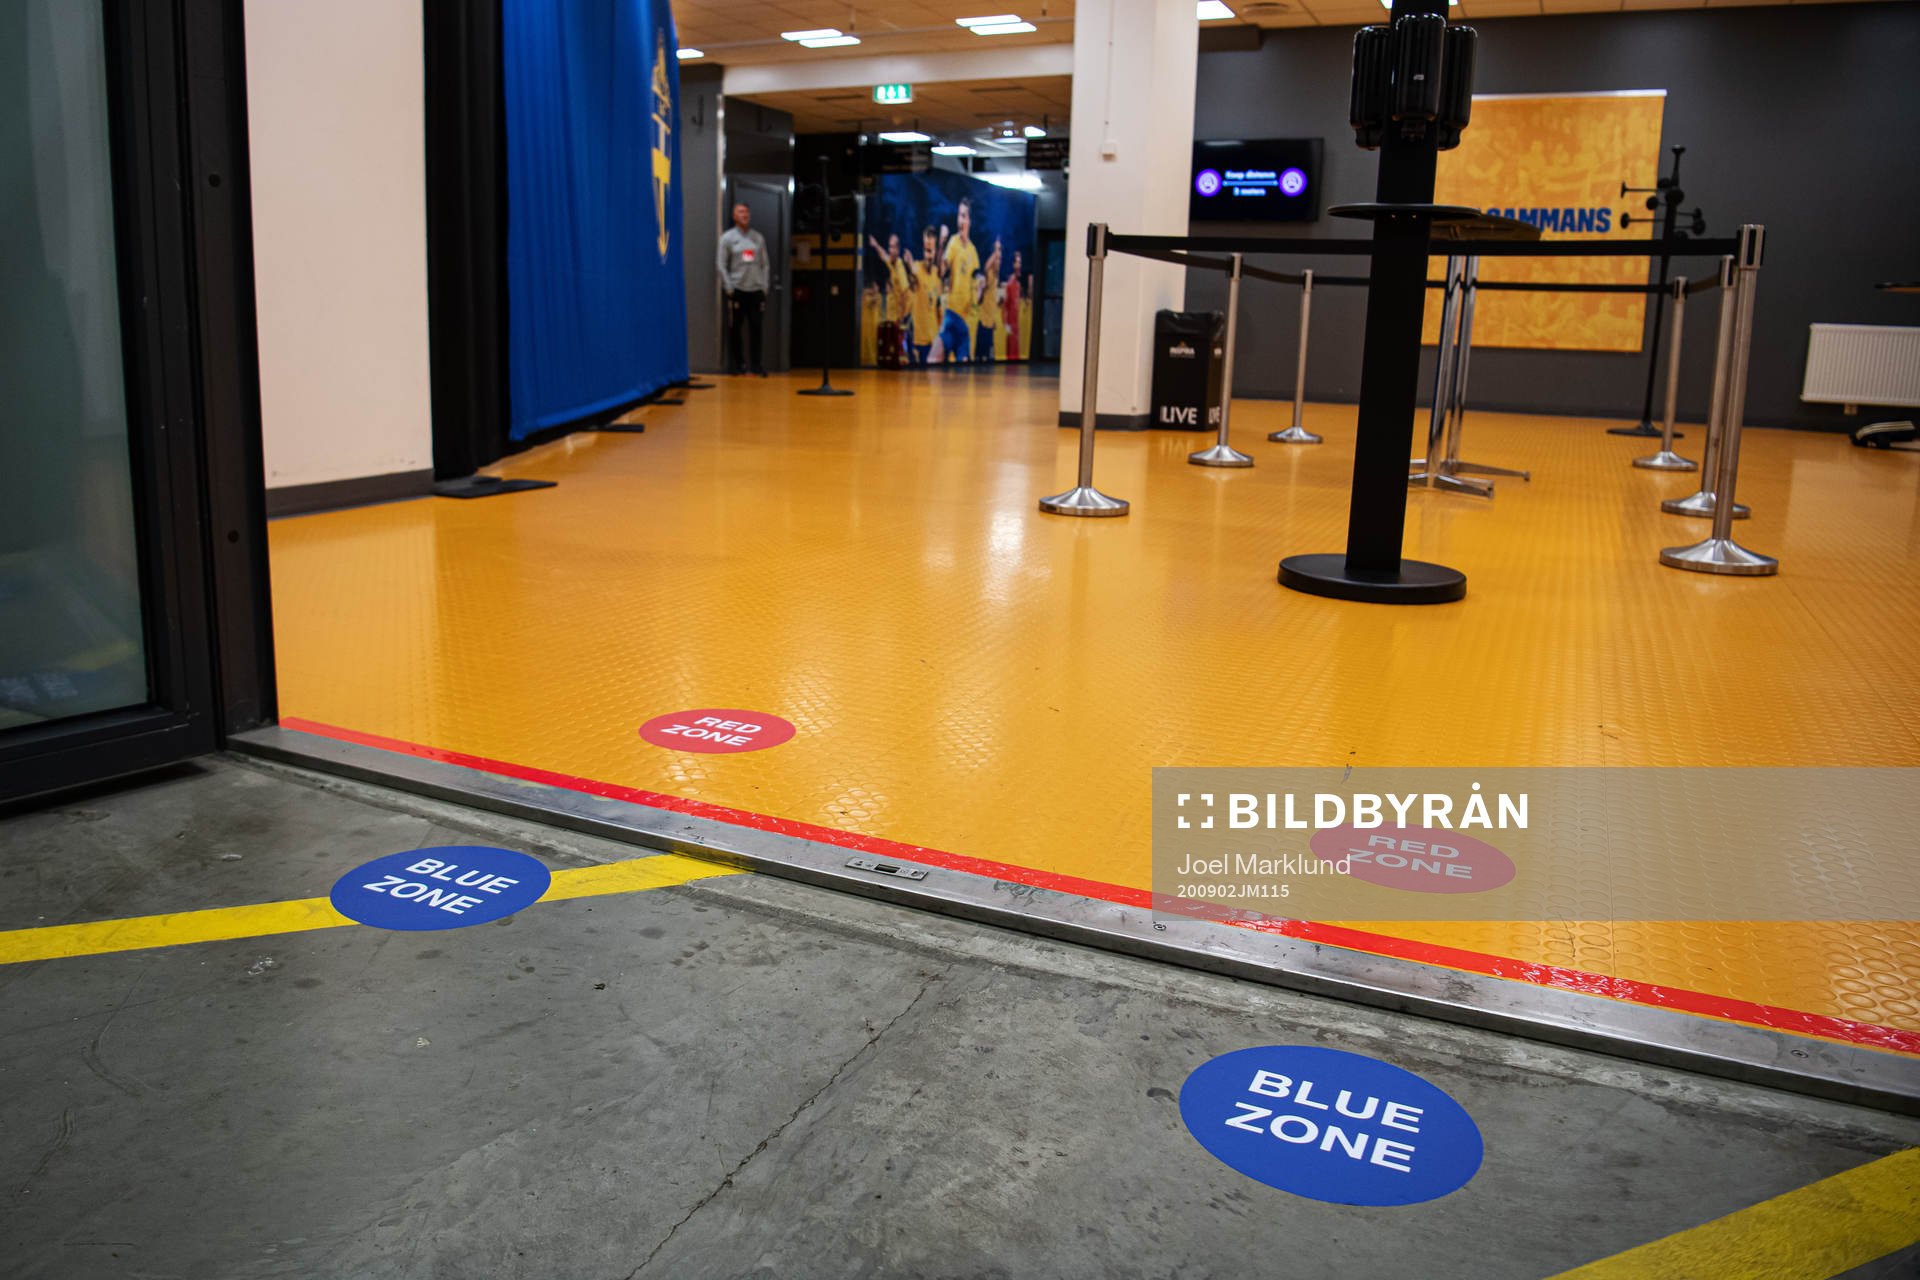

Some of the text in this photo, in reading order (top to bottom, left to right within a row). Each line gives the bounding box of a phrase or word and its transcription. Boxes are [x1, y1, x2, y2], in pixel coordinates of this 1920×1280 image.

[1161, 406, 1198, 424] LIVE
[660, 724, 752, 746] ZONE
[694, 717, 762, 733] RED
[1368, 834, 1460, 859] RED
[405, 858, 520, 894] BLUE
[1348, 848, 1472, 879] ZONE
[362, 875, 484, 915] ZONE
[1248, 1069, 1424, 1133] BLUE
[1224, 1101, 1416, 1173] ZONE
